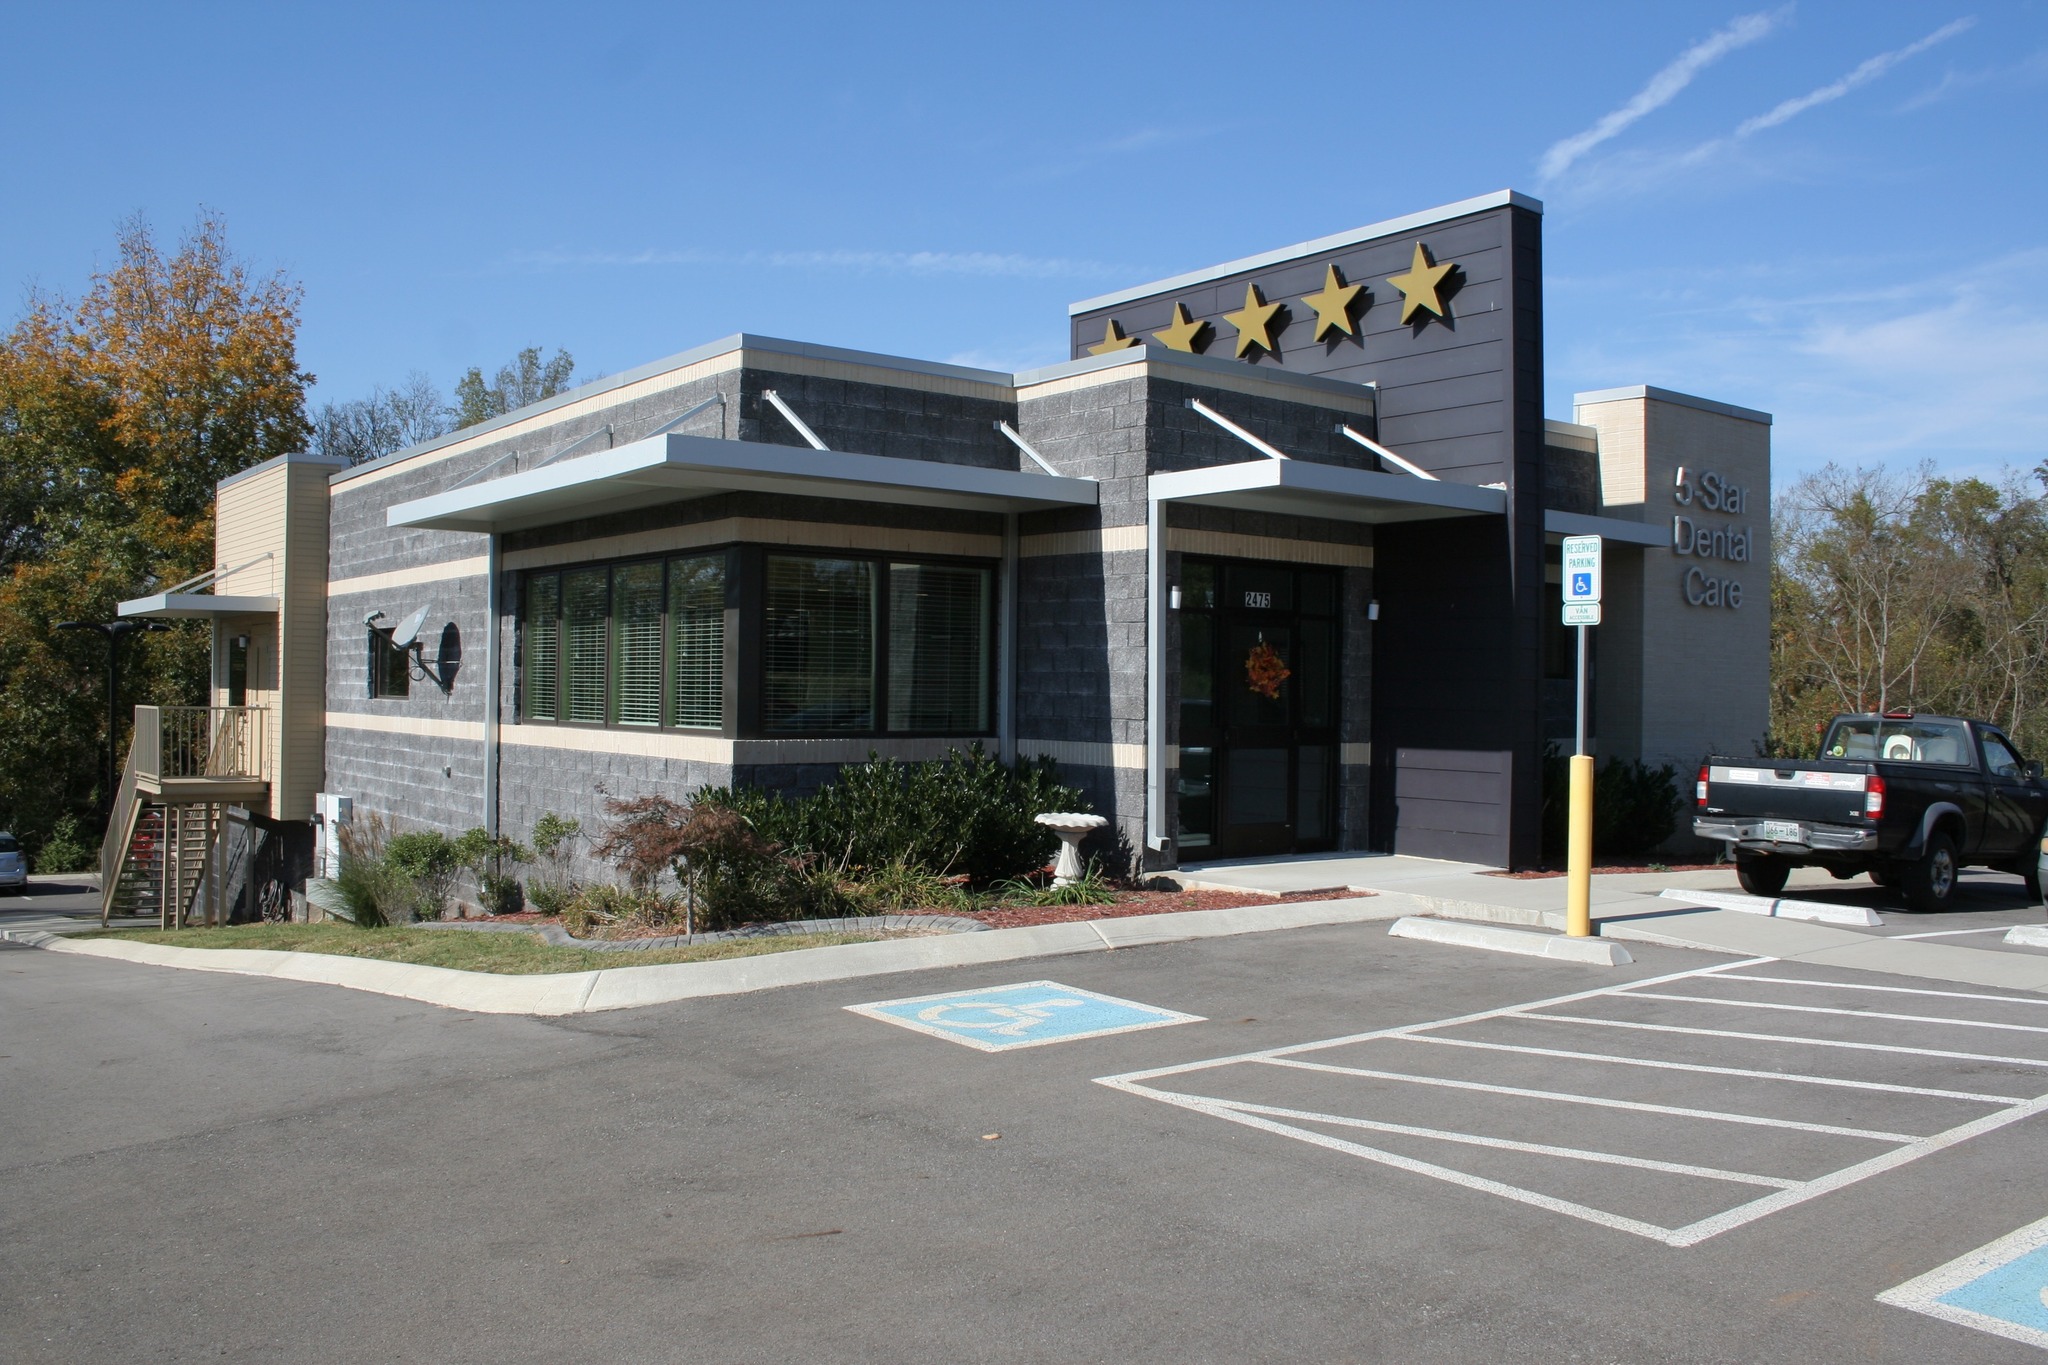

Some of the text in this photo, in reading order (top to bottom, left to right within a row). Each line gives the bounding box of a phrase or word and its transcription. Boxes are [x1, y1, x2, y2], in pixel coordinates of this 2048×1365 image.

[1674, 515, 1753, 562] Dental
[1566, 542, 1598, 554] RESERVED
[1568, 557, 1596, 568] PARKING
[1684, 566, 1743, 609] Care
[1246, 592, 1270, 608] 2475
